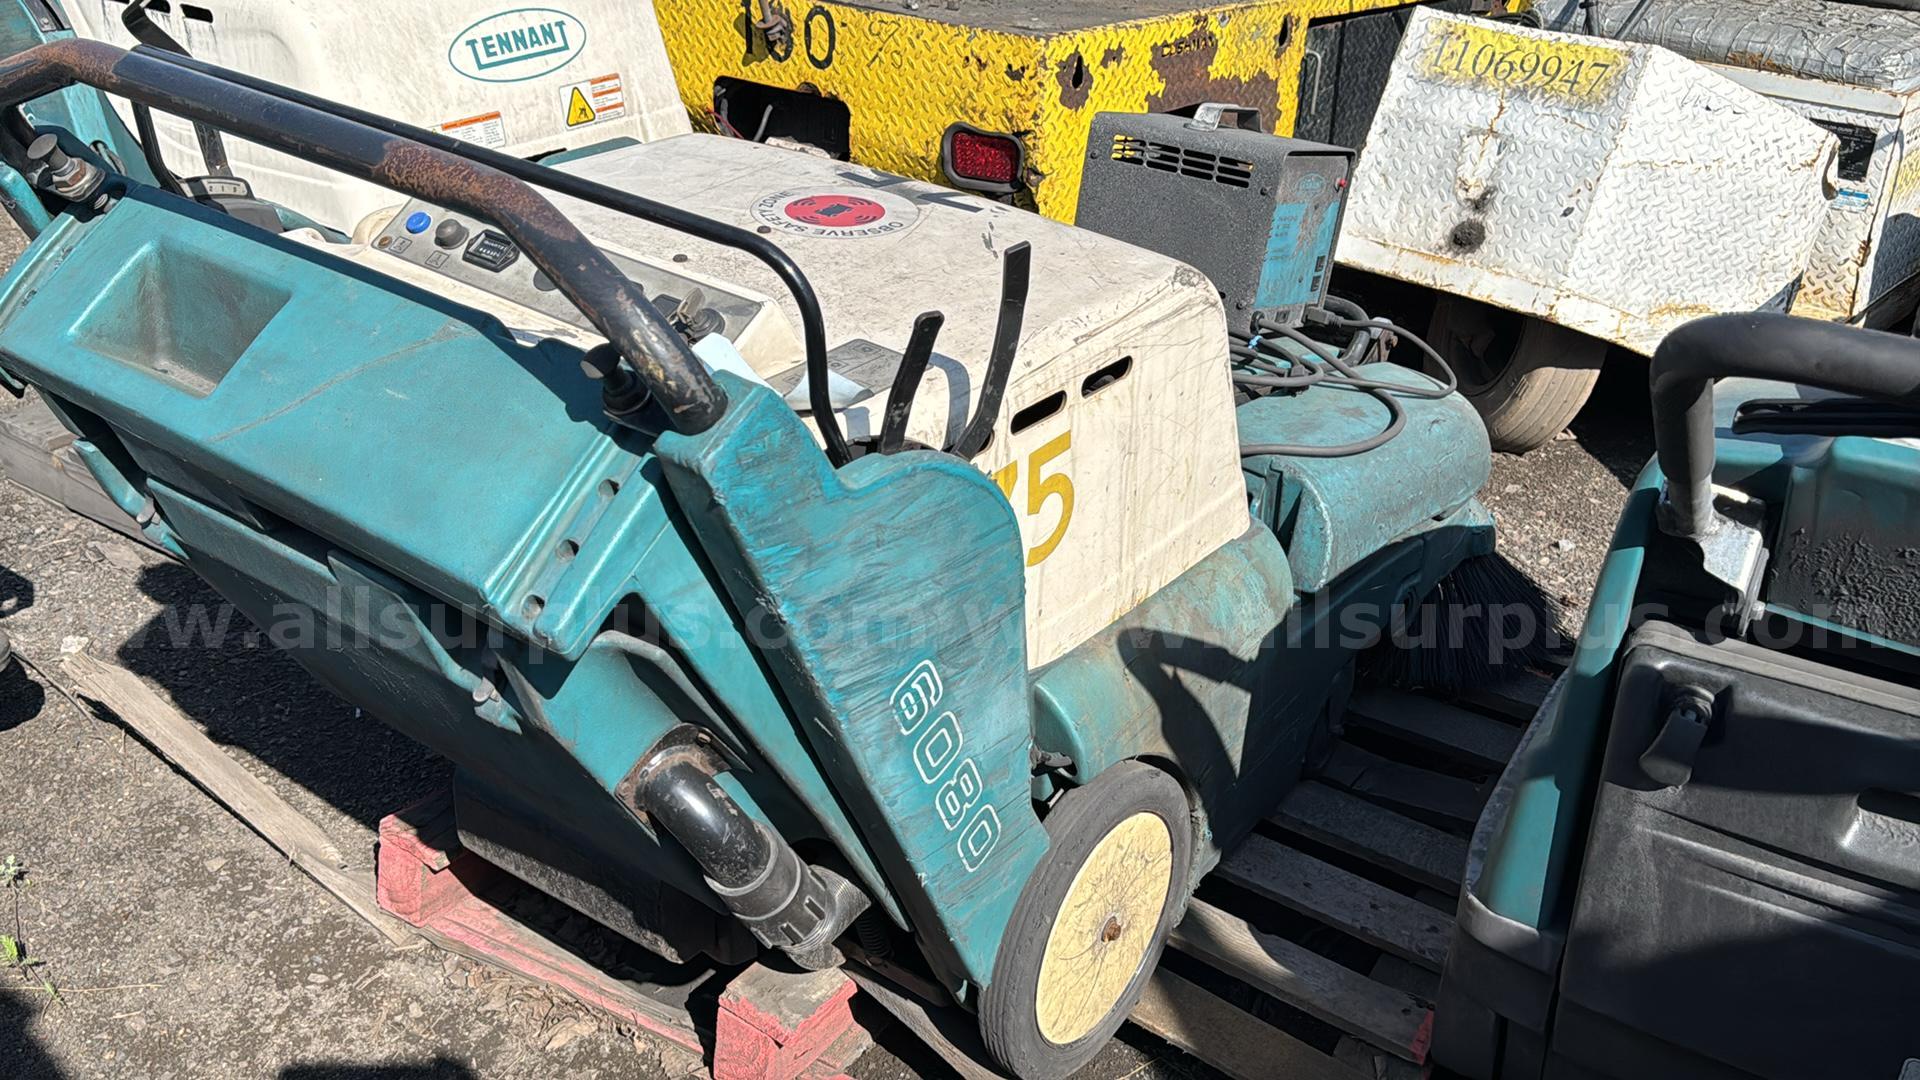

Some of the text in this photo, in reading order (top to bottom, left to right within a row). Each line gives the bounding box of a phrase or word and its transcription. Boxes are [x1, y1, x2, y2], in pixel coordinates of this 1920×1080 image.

[465, 20, 569, 70] TENNANT
[1431, 33, 1610, 95] 11069947
[758, 190, 904, 236] OBSERVE SAFETY ZONE
[889, 658, 1003, 873] 6080
